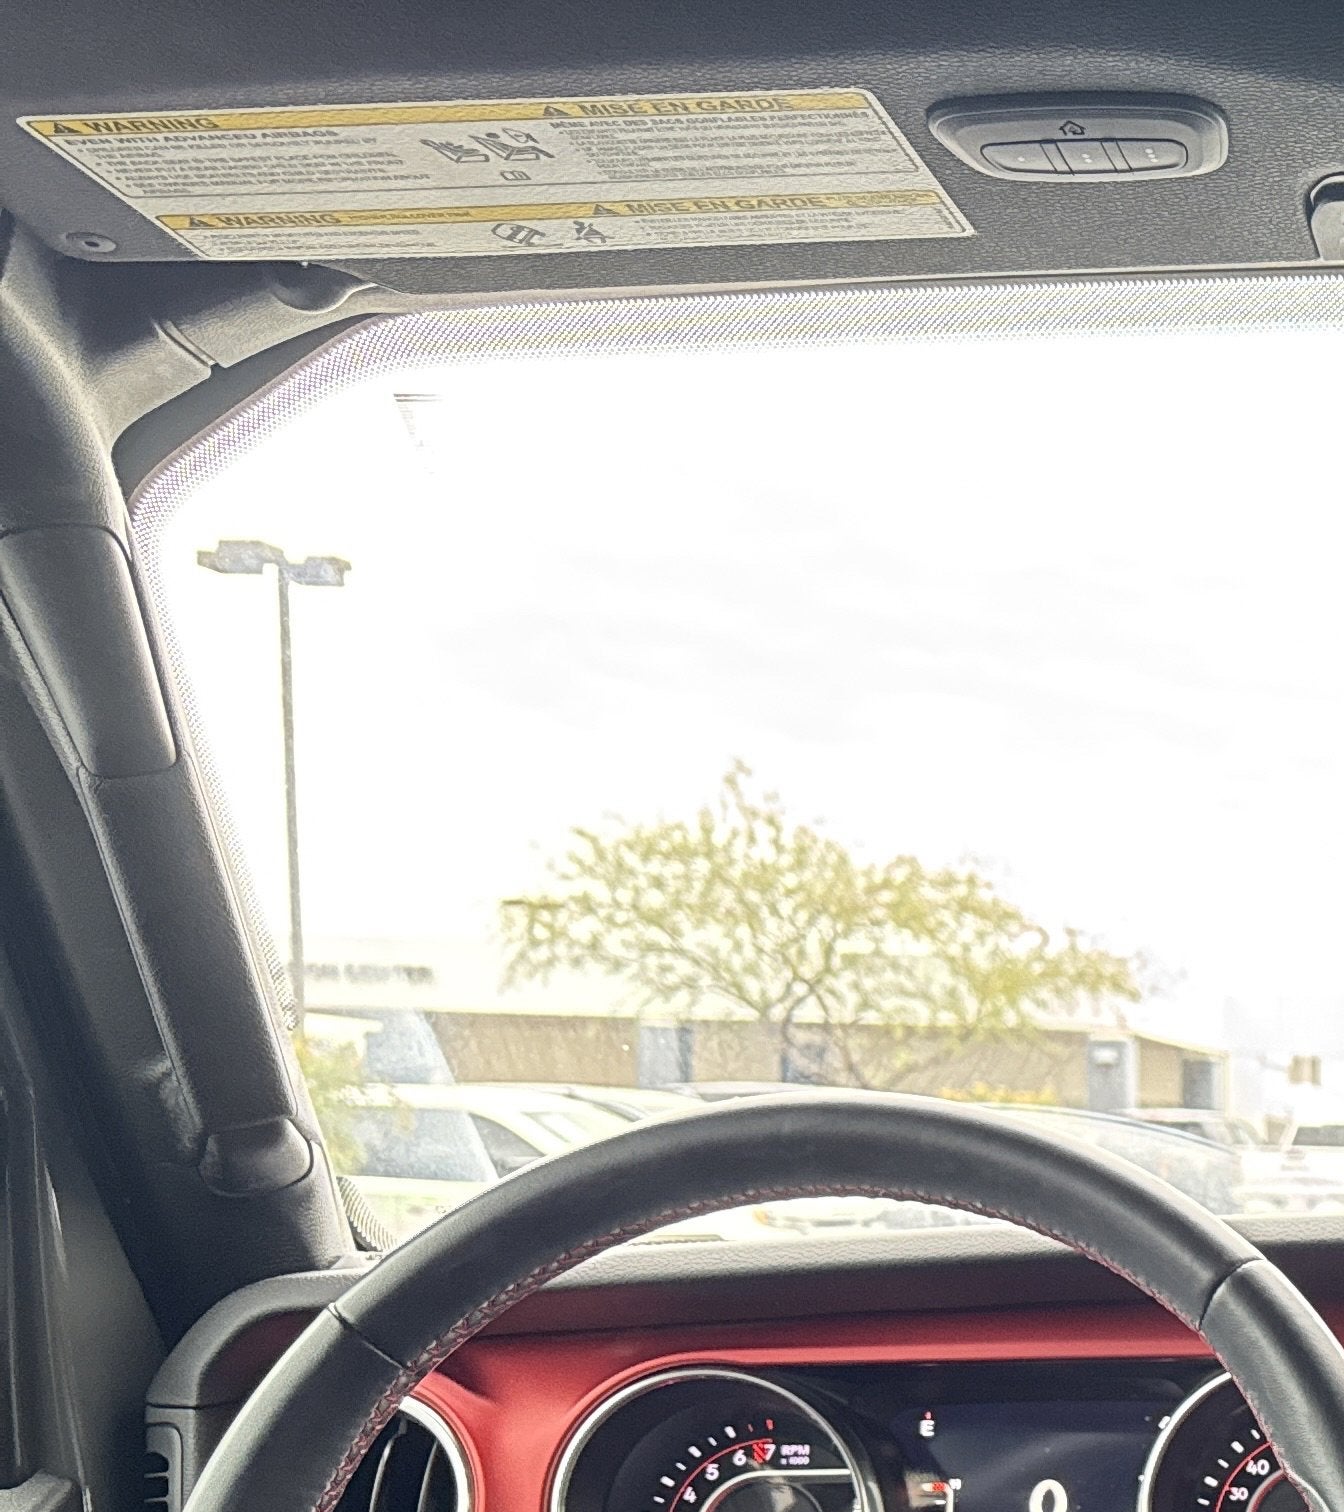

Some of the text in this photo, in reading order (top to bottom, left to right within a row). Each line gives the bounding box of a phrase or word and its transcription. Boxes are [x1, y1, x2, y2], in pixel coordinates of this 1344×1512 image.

[577, 97, 794, 116] MISE EN GARDE
[82, 117, 221, 134] WARNING
[626, 201, 690, 216] MISE
[697, 200, 735, 211] EN
[739, 195, 824, 210] GARDE
[215, 213, 342, 228] WARNING
[919, 1419, 935, 1437] E
[732, 1449, 747, 1466] 6
[764, 1444, 777, 1461] 7
[780, 1444, 811, 1457] RPM
[704, 1463, 720, 1481] 5
[1246, 1458, 1270, 1476] 40
[683, 1486, 697, 1504] 4
[1228, 1486, 1249, 1501] 30
